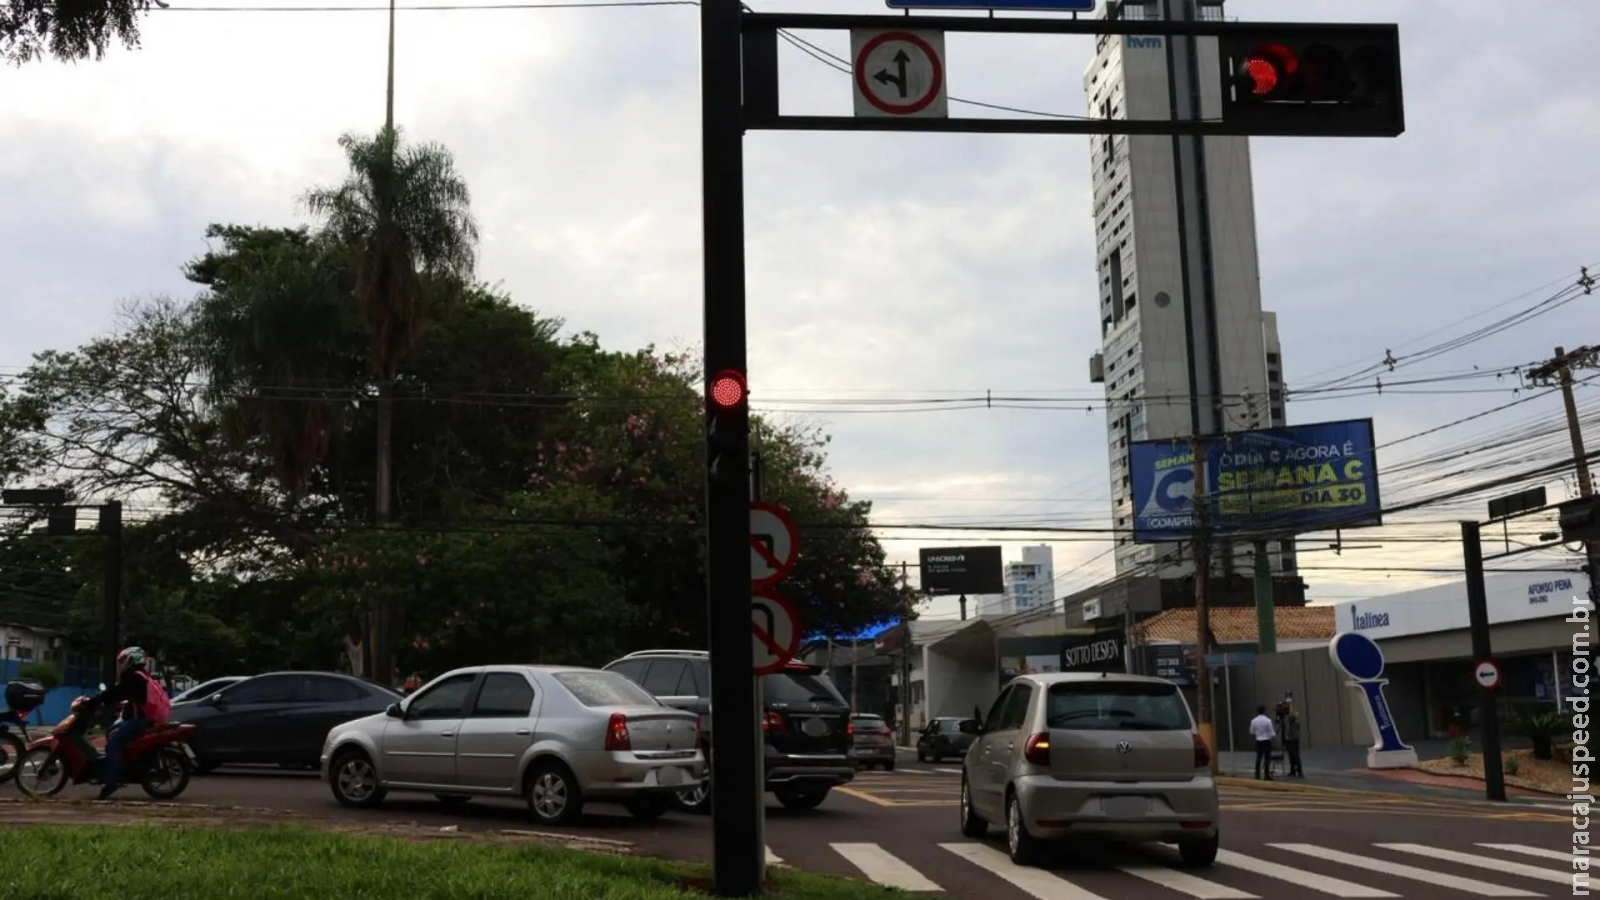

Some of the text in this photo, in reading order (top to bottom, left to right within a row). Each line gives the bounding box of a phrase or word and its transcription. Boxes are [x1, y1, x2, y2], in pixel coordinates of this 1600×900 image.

[1154, 452, 1195, 470] SEMAN
[1234, 451, 1265, 466] DIA
[1270, 449, 1281, 462] C
[1285, 444, 1341, 461] AGORA
[1343, 440, 1355, 456] É
[1218, 459, 1365, 491] SEMANA C
[1301, 490, 1333, 504] DIA
[1338, 487, 1362, 501] 30
[1528, 578, 1573, 595] AFONSO PENA
[1066, 639, 1119, 667] SOTTO DESIGN
